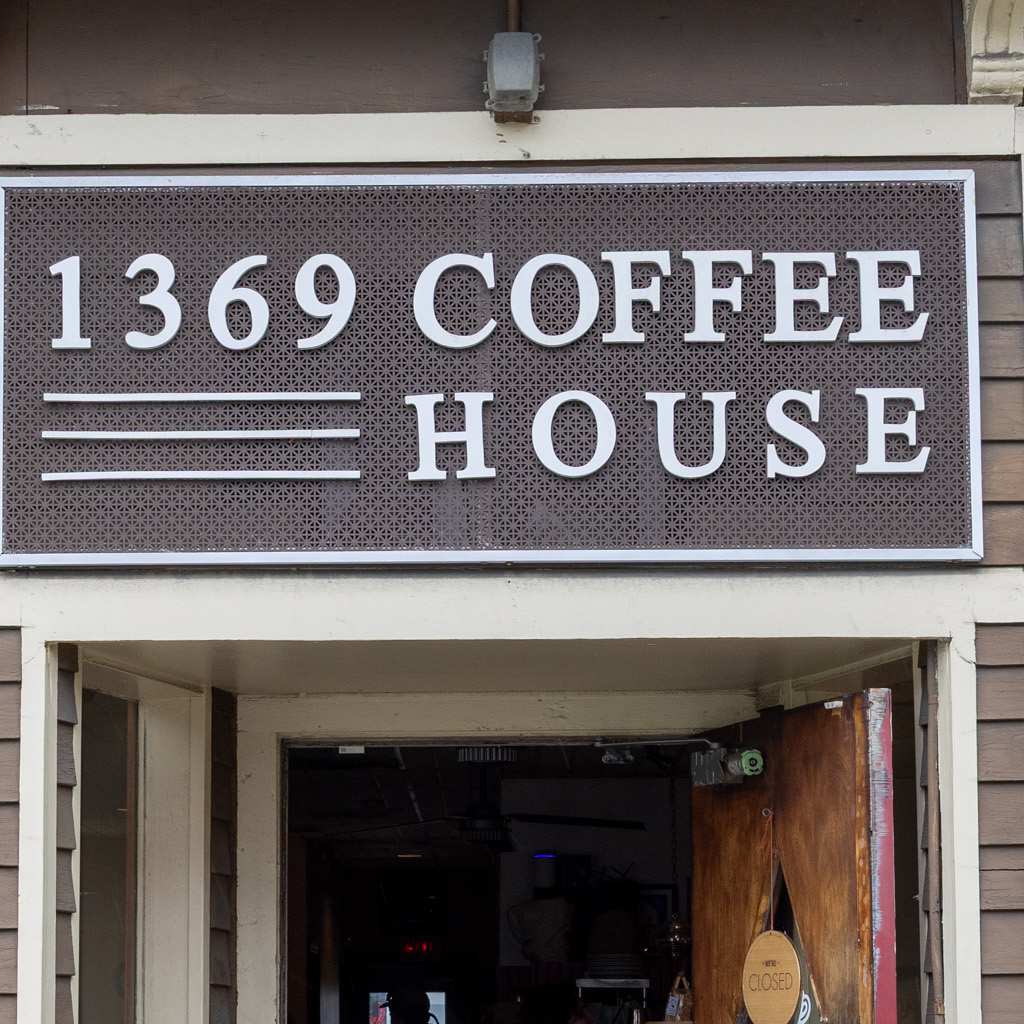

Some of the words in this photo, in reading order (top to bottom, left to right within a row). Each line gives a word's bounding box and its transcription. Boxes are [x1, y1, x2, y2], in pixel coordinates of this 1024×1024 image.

[48, 252, 357, 352] 1369
[412, 248, 931, 350] COFFEE
[404, 387, 932, 480] HOUSE
[748, 972, 793, 991] CLOSED
